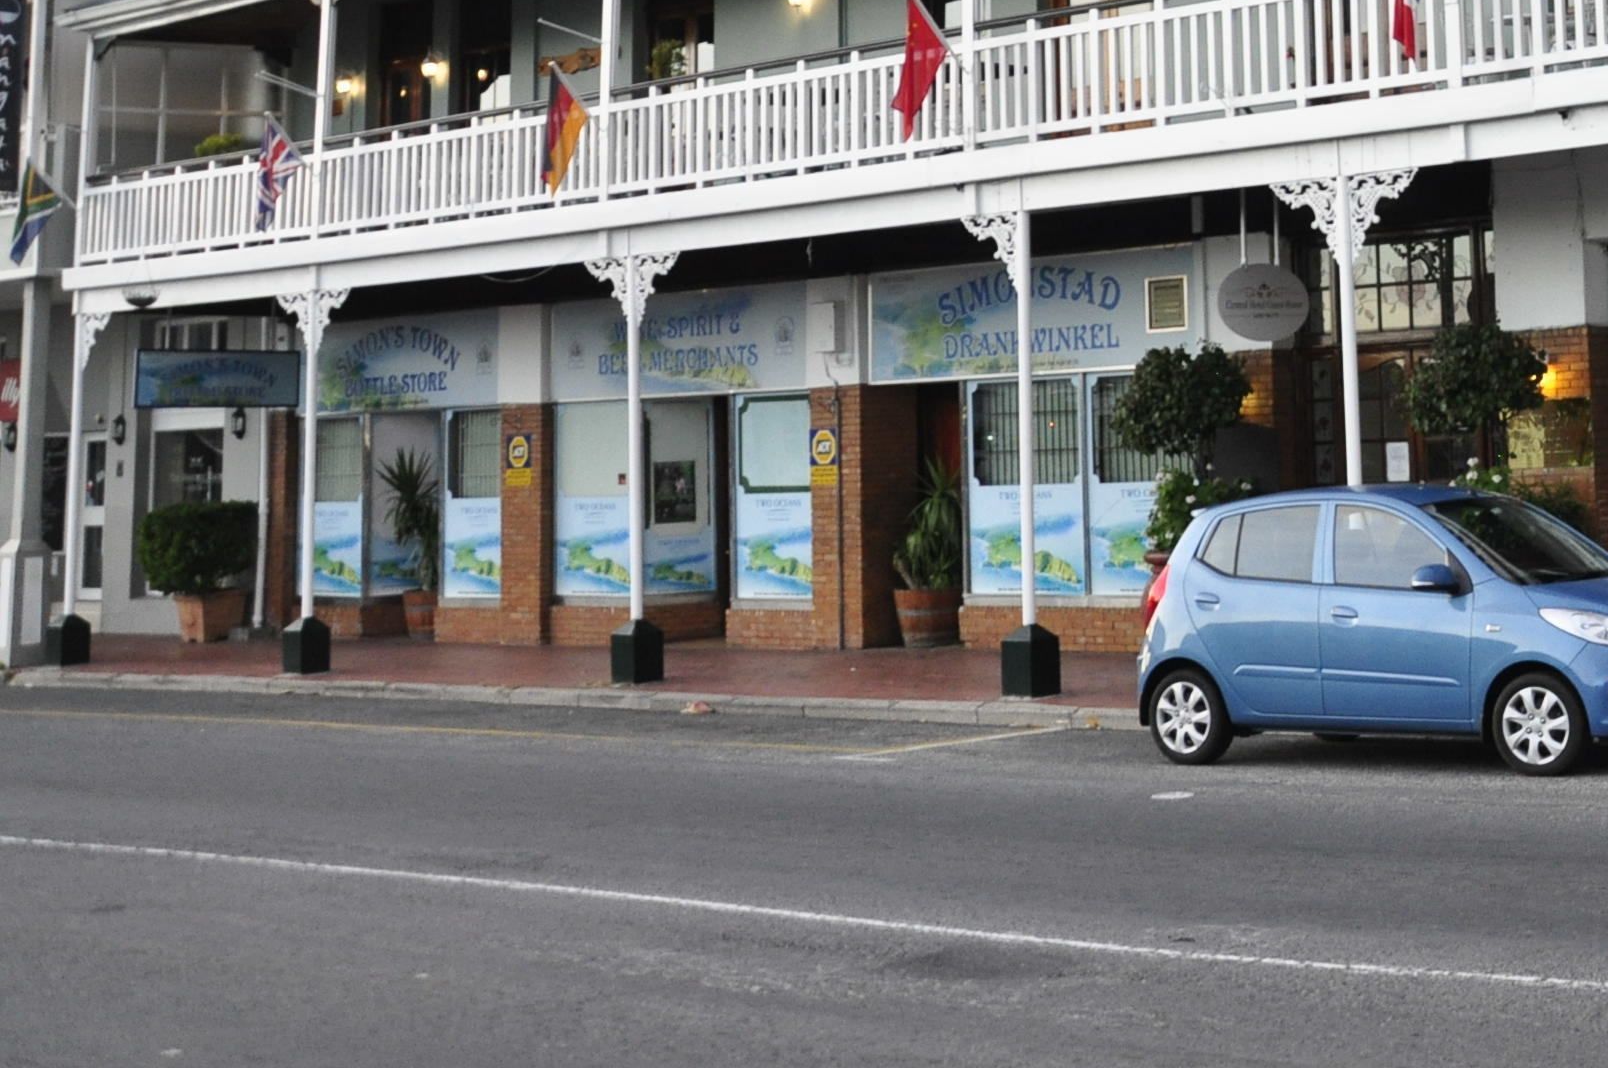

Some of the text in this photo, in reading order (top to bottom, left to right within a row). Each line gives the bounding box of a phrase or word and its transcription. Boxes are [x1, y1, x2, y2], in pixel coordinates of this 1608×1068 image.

[667, 313, 722, 339] SPIRIT
[411, 326, 460, 371] TOWN
[649, 343, 759, 372] MERCHANTS
[401, 371, 448, 393] STORE
